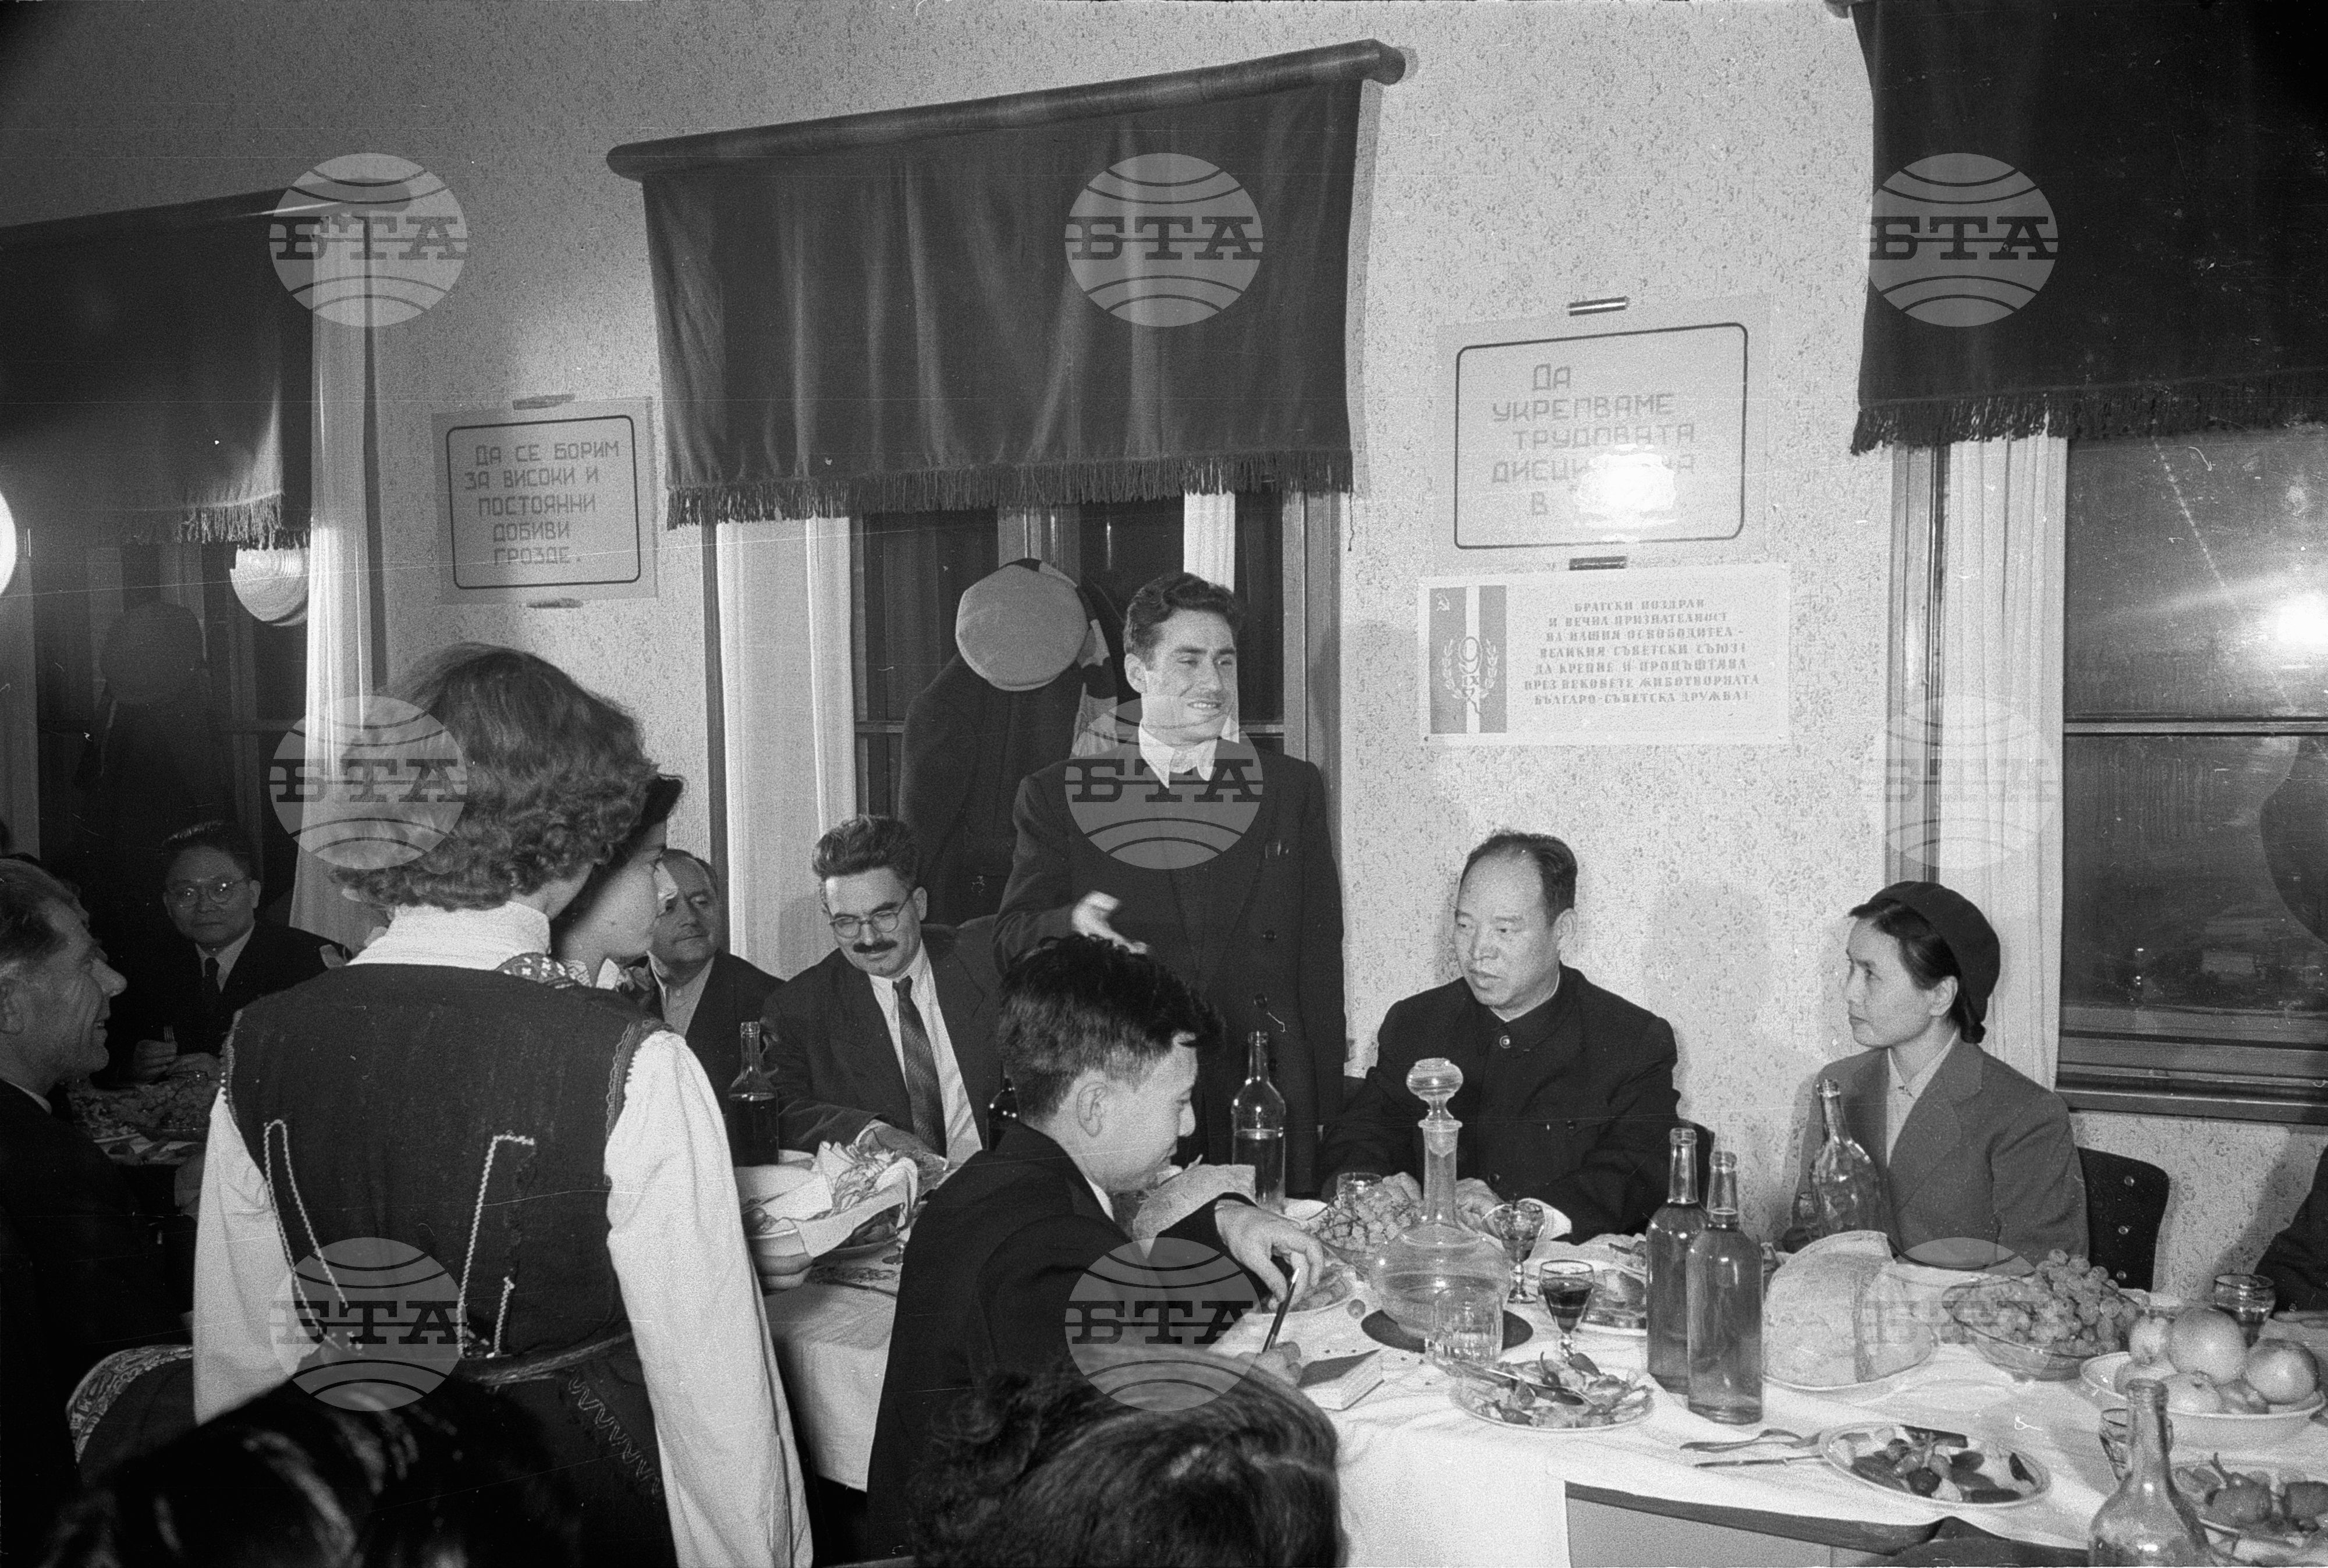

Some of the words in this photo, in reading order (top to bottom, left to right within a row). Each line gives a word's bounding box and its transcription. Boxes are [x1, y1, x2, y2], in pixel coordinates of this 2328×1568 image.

[1532, 363, 1571, 391] ДА
[1492, 392, 1674, 422] УКРЕПВАМЕ
[1512, 423, 1695, 450] ТРУДОВАТА
[475, 445, 502, 466] ДА
[515, 444, 541, 462] СЕ
[554, 440, 619, 460] БОРИМ
[464, 471, 489, 490] ЗА
[503, 467, 575, 488] ВИСОКИ
[585, 466, 599, 484] И
[478, 493, 596, 517] ПОСТОЯННИ
[1531, 491, 1549, 516] В
[493, 521, 570, 542] ДОБИВИ
[1574, 601, 1633, 612] БРАТСКИ
[1548, 617, 1557, 627] И
[1565, 616, 1609, 627] ВЕЧНА
[1546, 631, 1562, 641] НА
[1570, 630, 1620, 641] НАШИЯ
[1627, 627, 1733, 640] ОСВОБОДИТЕЛ
[1540, 646, 1605, 659] ВЕЛИКИЯ
[1613, 644, 1687, 657] СЪВЕТСКИ
[1534, 664, 1552, 675] ДА
[1622, 661, 1631, 672] И
[1524, 679, 1556, 690] ПРЕЗ
[1562, 677, 1634, 689] ВЕКОВЕТЕ
